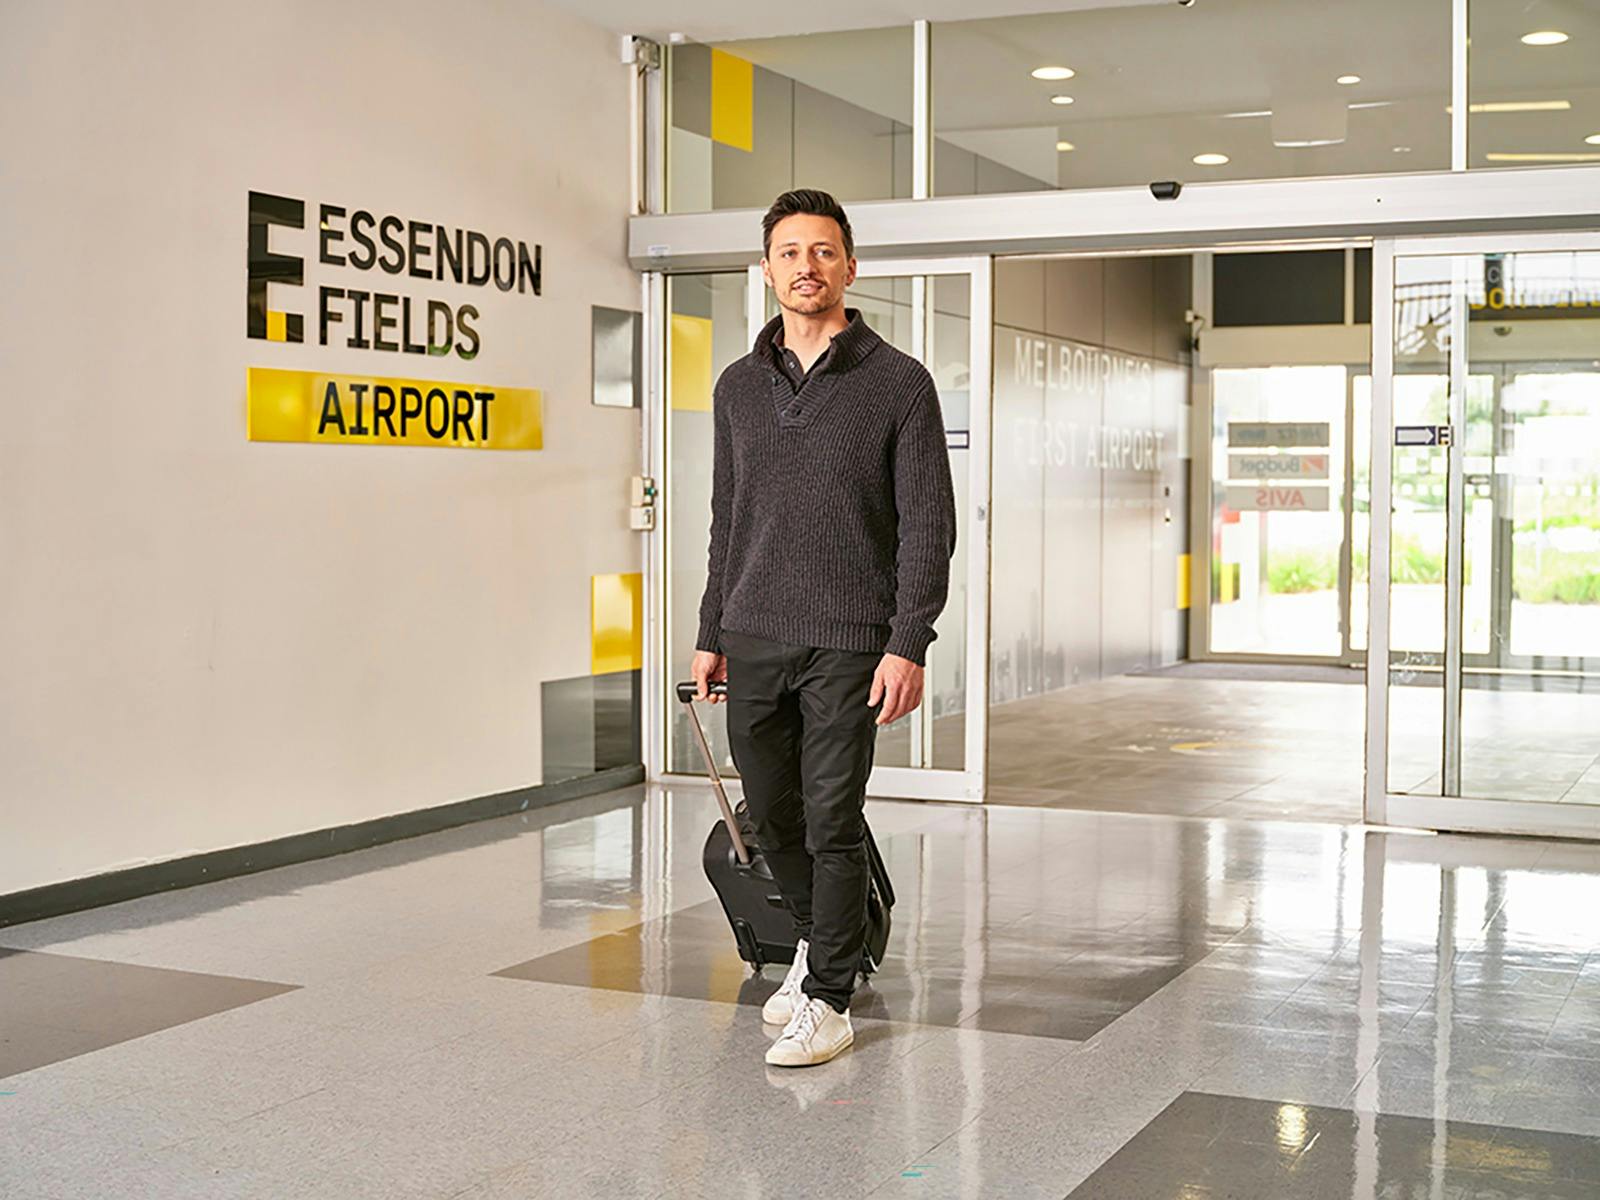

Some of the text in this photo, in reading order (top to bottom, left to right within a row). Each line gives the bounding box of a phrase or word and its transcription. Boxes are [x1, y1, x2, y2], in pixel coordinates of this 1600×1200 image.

[319, 203, 542, 296] ESSENDON
[319, 286, 480, 360] FIELDS
[317, 381, 495, 441] AIRPORT
[1085, 424, 1164, 471] AIRPORT
